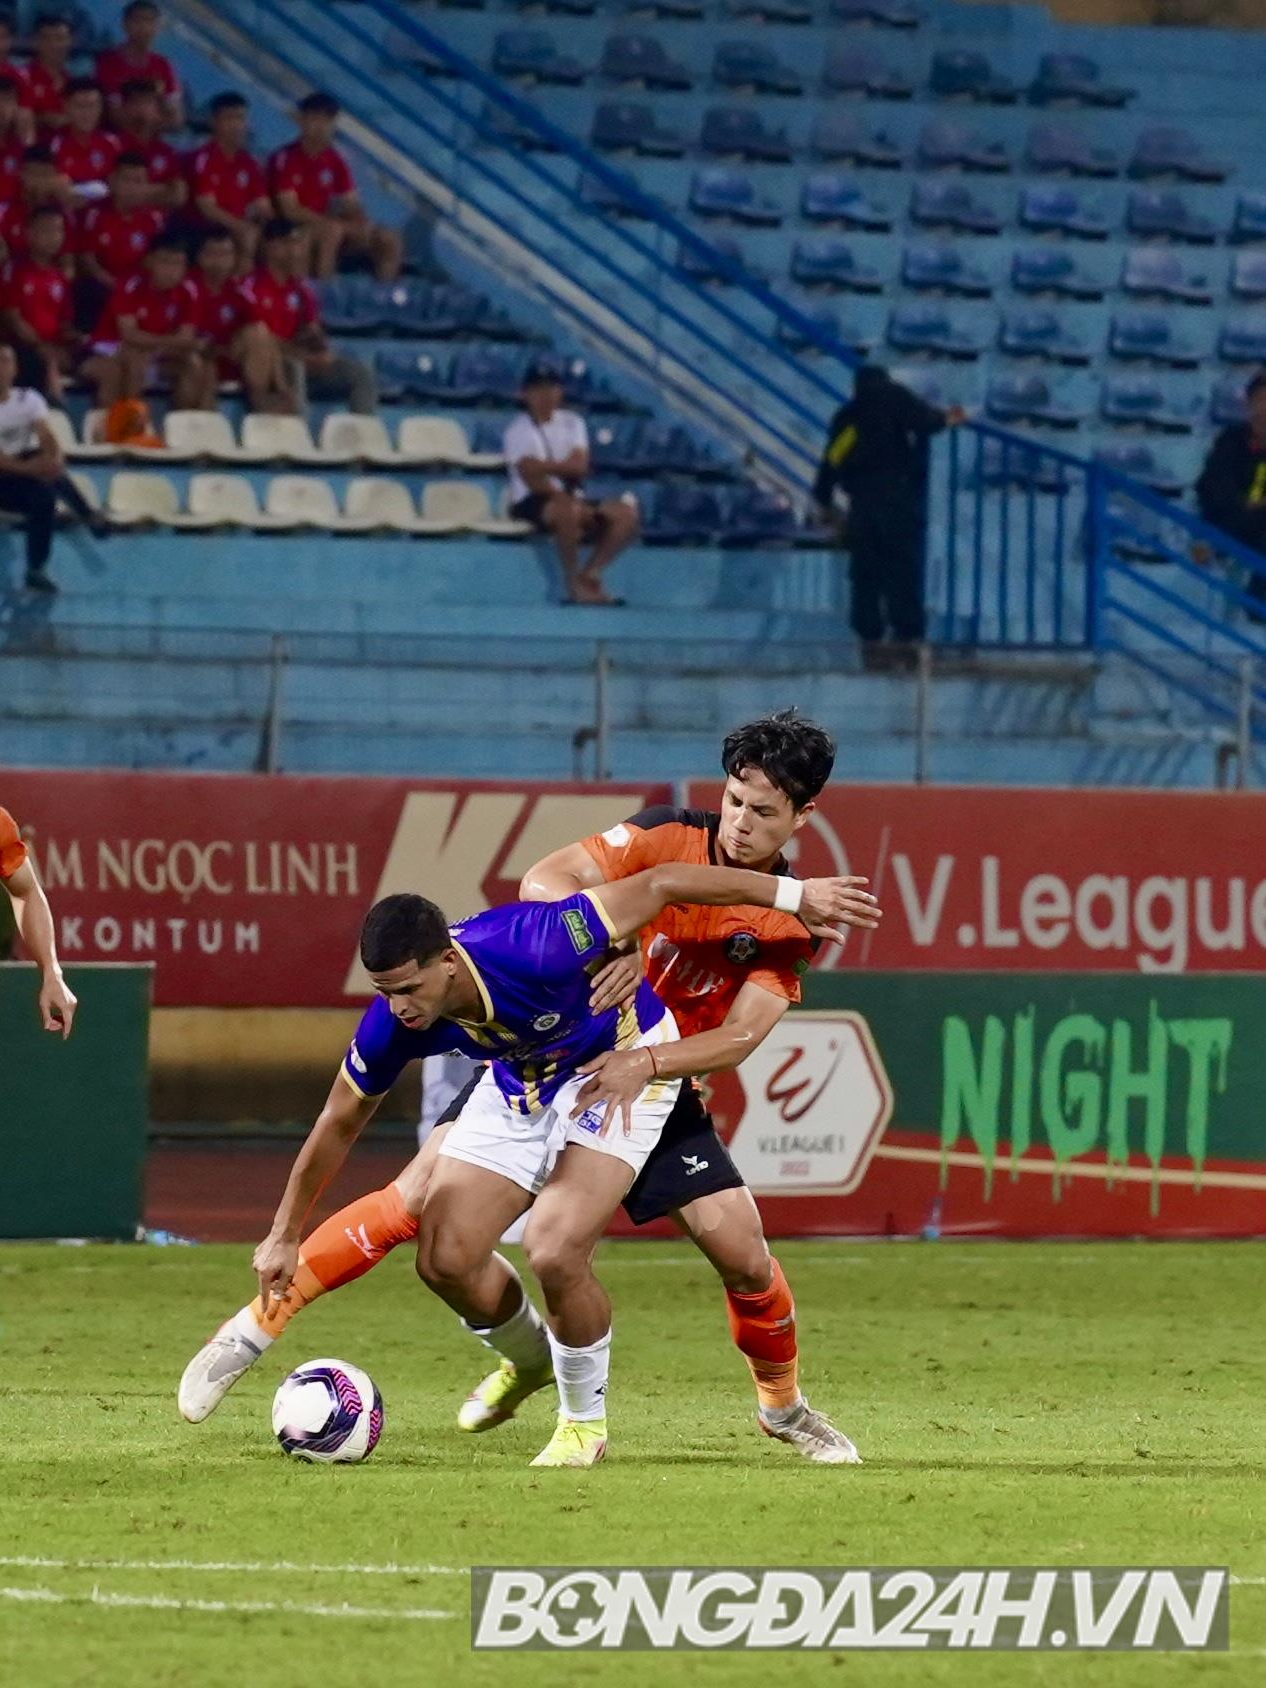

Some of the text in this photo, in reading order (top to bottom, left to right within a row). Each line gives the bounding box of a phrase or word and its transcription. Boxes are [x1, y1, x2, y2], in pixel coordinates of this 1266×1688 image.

[97, 839, 232, 904] NGỌC
[245, 841, 359, 895] LINH
[61, 917, 261, 953] KONTUM
[939, 998, 1232, 1218] NIGHT
